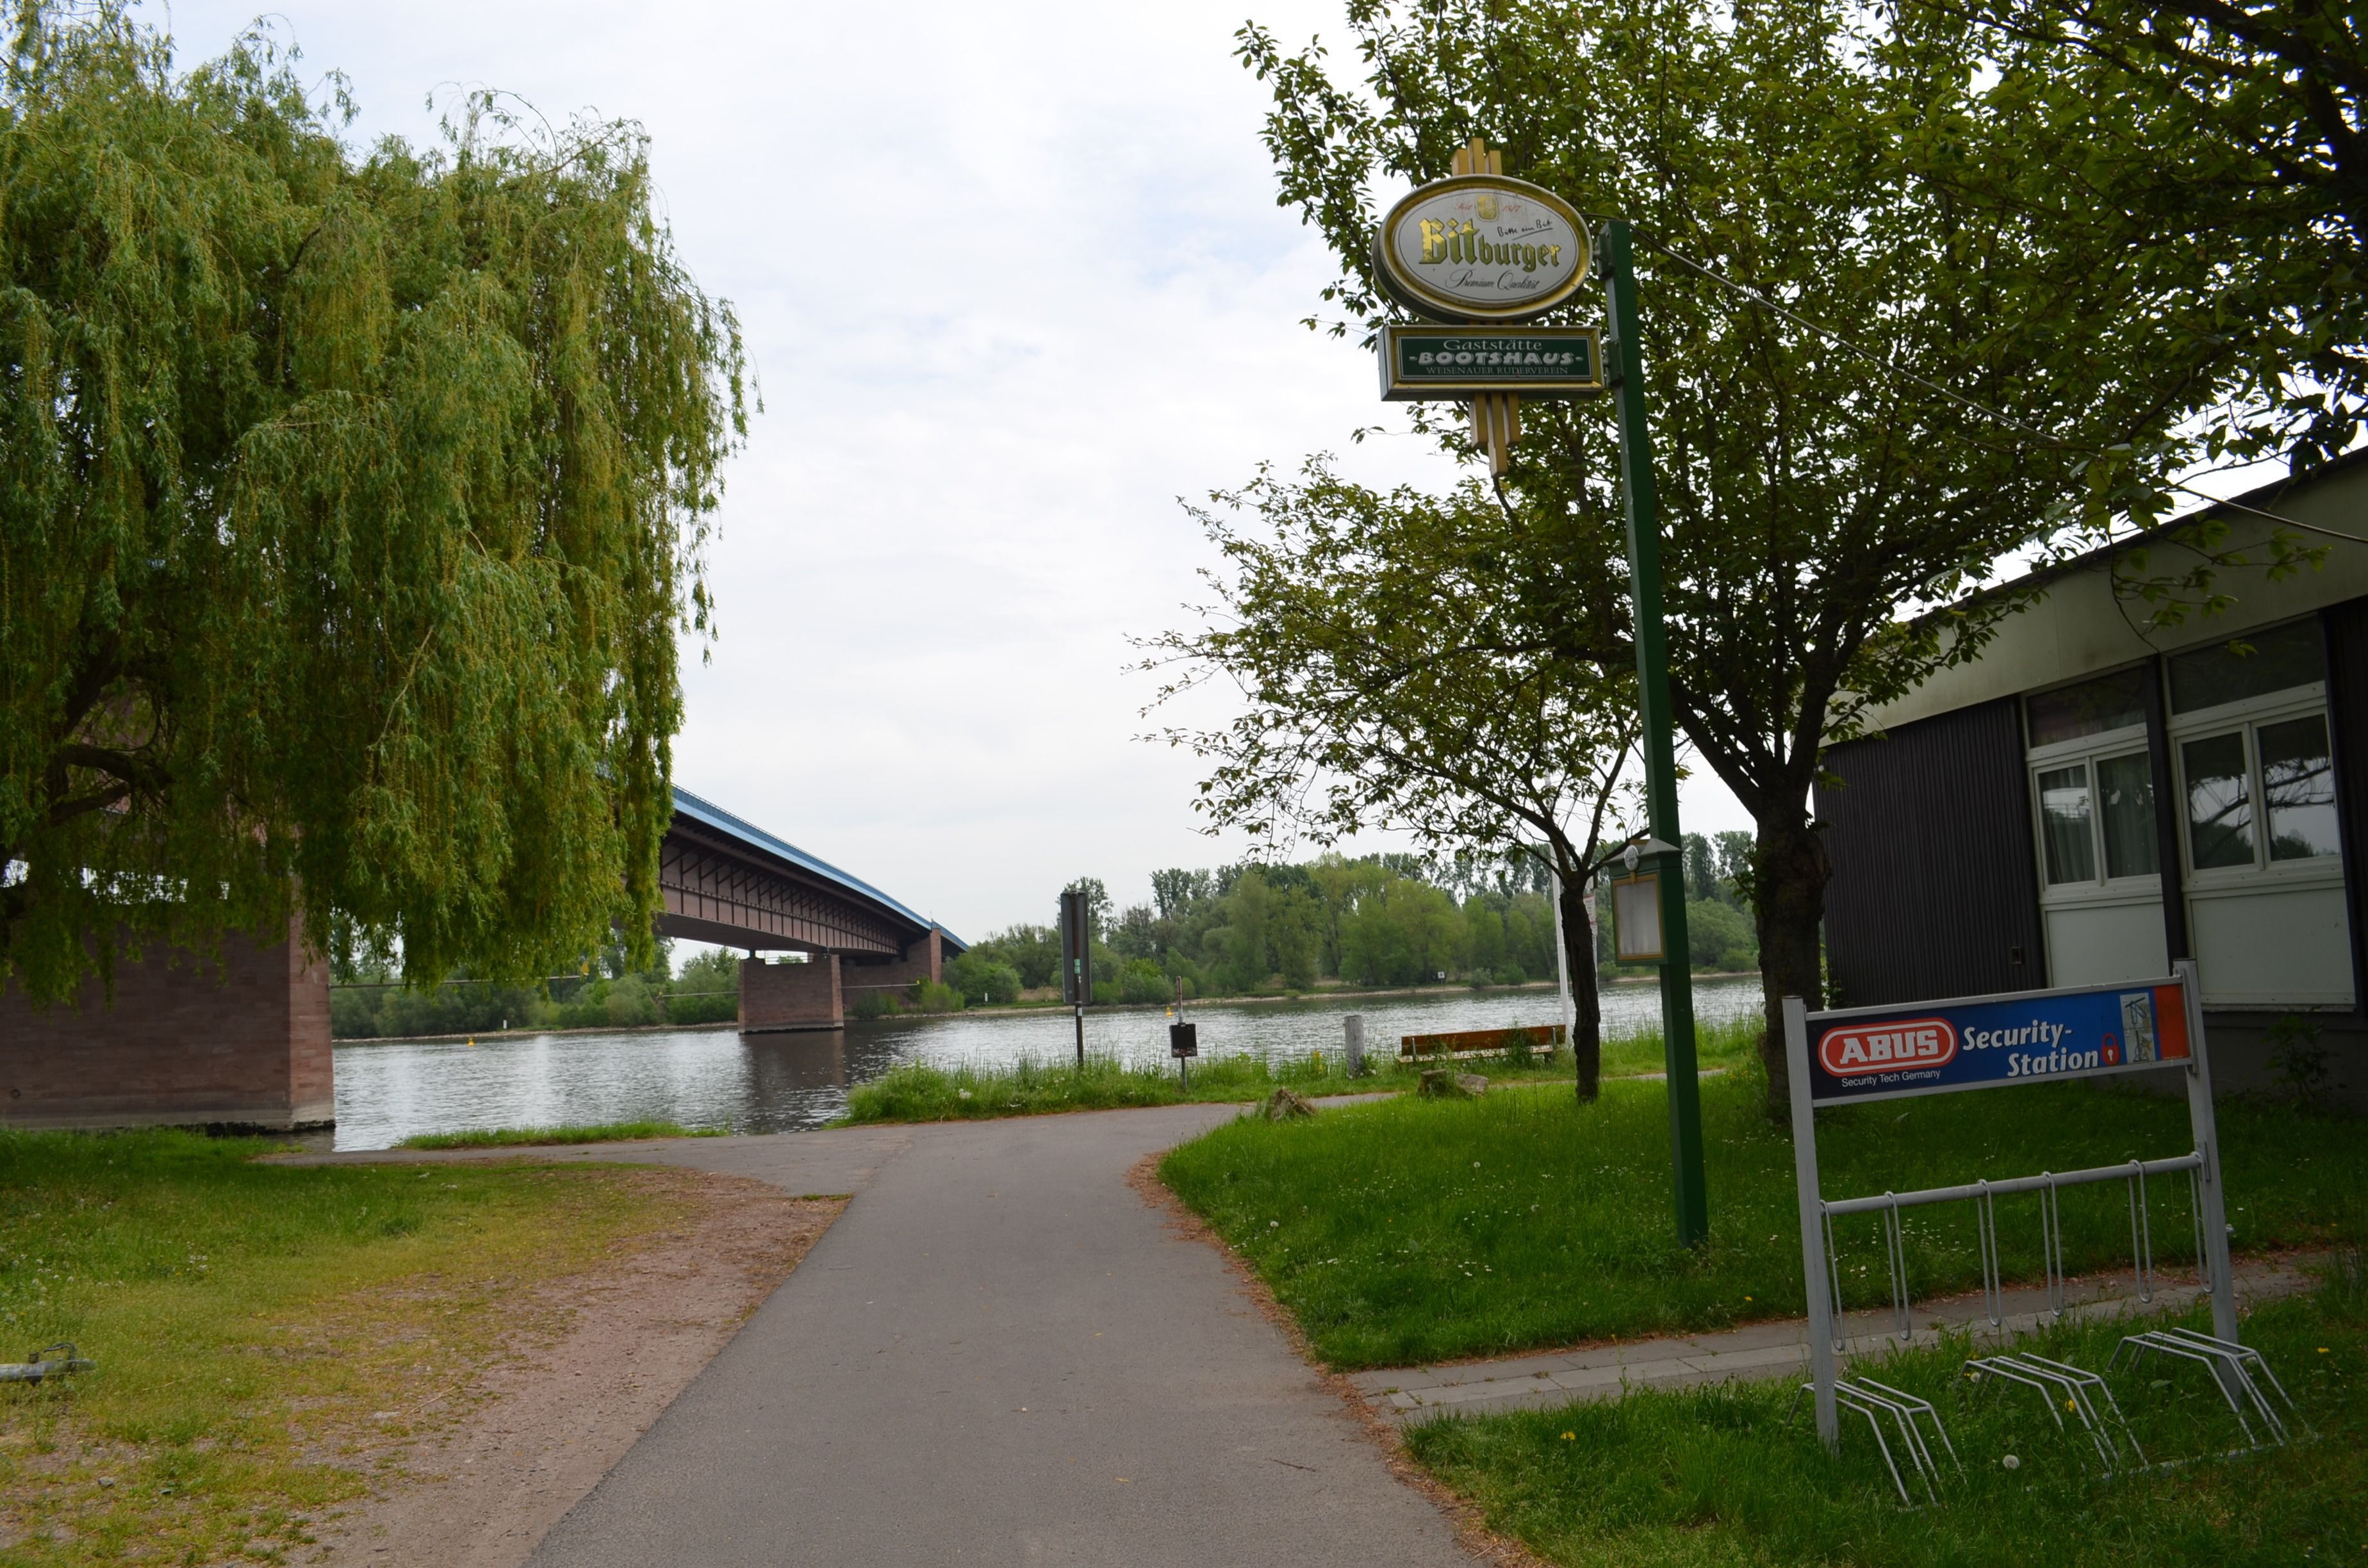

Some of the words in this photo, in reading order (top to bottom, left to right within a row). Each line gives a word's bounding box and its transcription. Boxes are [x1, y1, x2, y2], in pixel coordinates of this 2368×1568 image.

[1497, 226, 1518, 237] Bitte
[1536, 219, 1553, 229] Bit
[1418, 217, 1561, 273] Bitburger
[1445, 268, 1495, 289] Premium
[1497, 270, 1540, 290] Qualität
[1443, 339, 1543, 351] Gaststätte
[1426, 366, 1494, 375] WEISENAUER
[1497, 366, 1568, 375] RUDERVEREIN
[1839, 1029, 1939, 1065] ABUS
[2007, 1047, 2100, 1077] Station
[1841, 1075, 1877, 1088] Security
[1879, 1072, 1900, 1084] Tech
[1902, 1070, 1941, 1081] Germany
